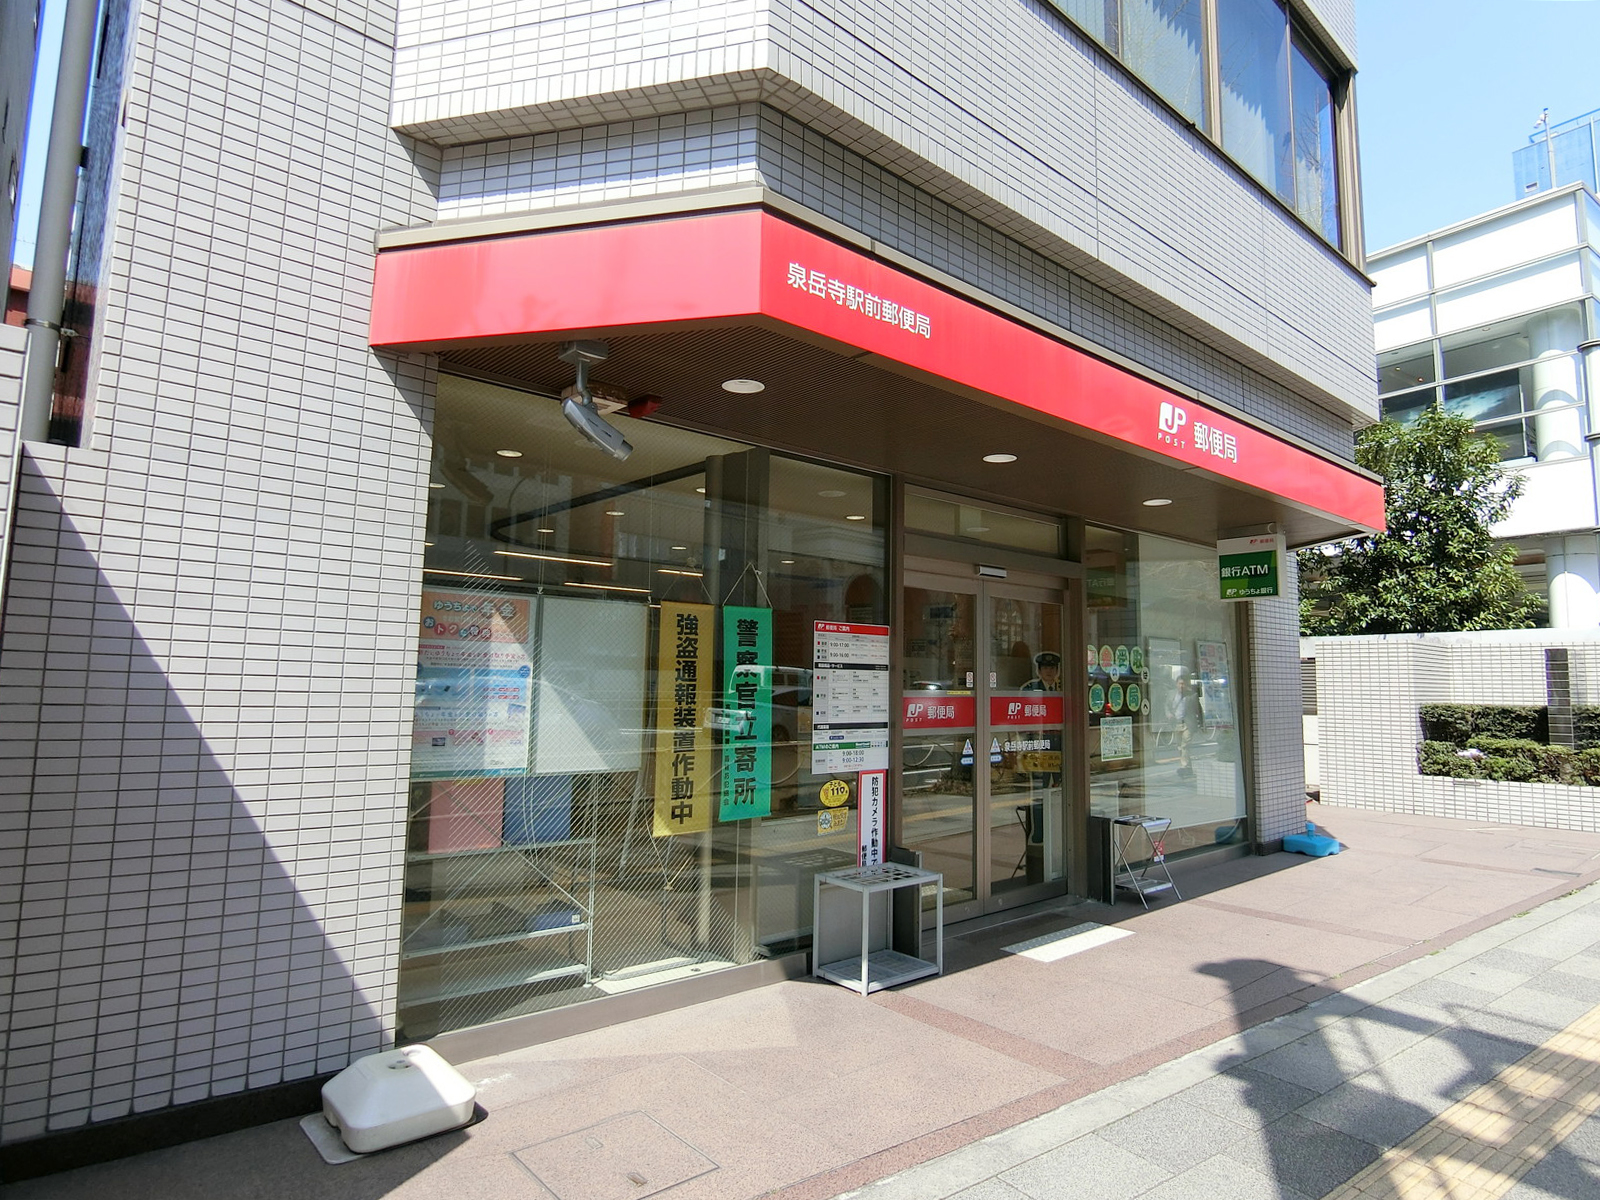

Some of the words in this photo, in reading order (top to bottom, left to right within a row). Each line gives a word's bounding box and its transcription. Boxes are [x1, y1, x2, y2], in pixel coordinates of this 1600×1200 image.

[787, 262, 931, 339] 泉岳寺駅前郵便局
[1157, 432, 1186, 449] POST
[1194, 421, 1237, 464] 郵便局
[1221, 565, 1268, 578] 銀行ATM
[1239, 586, 1273, 595] ゆうちょ銀行
[671, 613, 699, 825] 強盗通報装置作動中
[733, 619, 759, 806] 警察官立寄所
[927, 705, 955, 720] 郵便局
[1024, 704, 1047, 717] 郵便局
